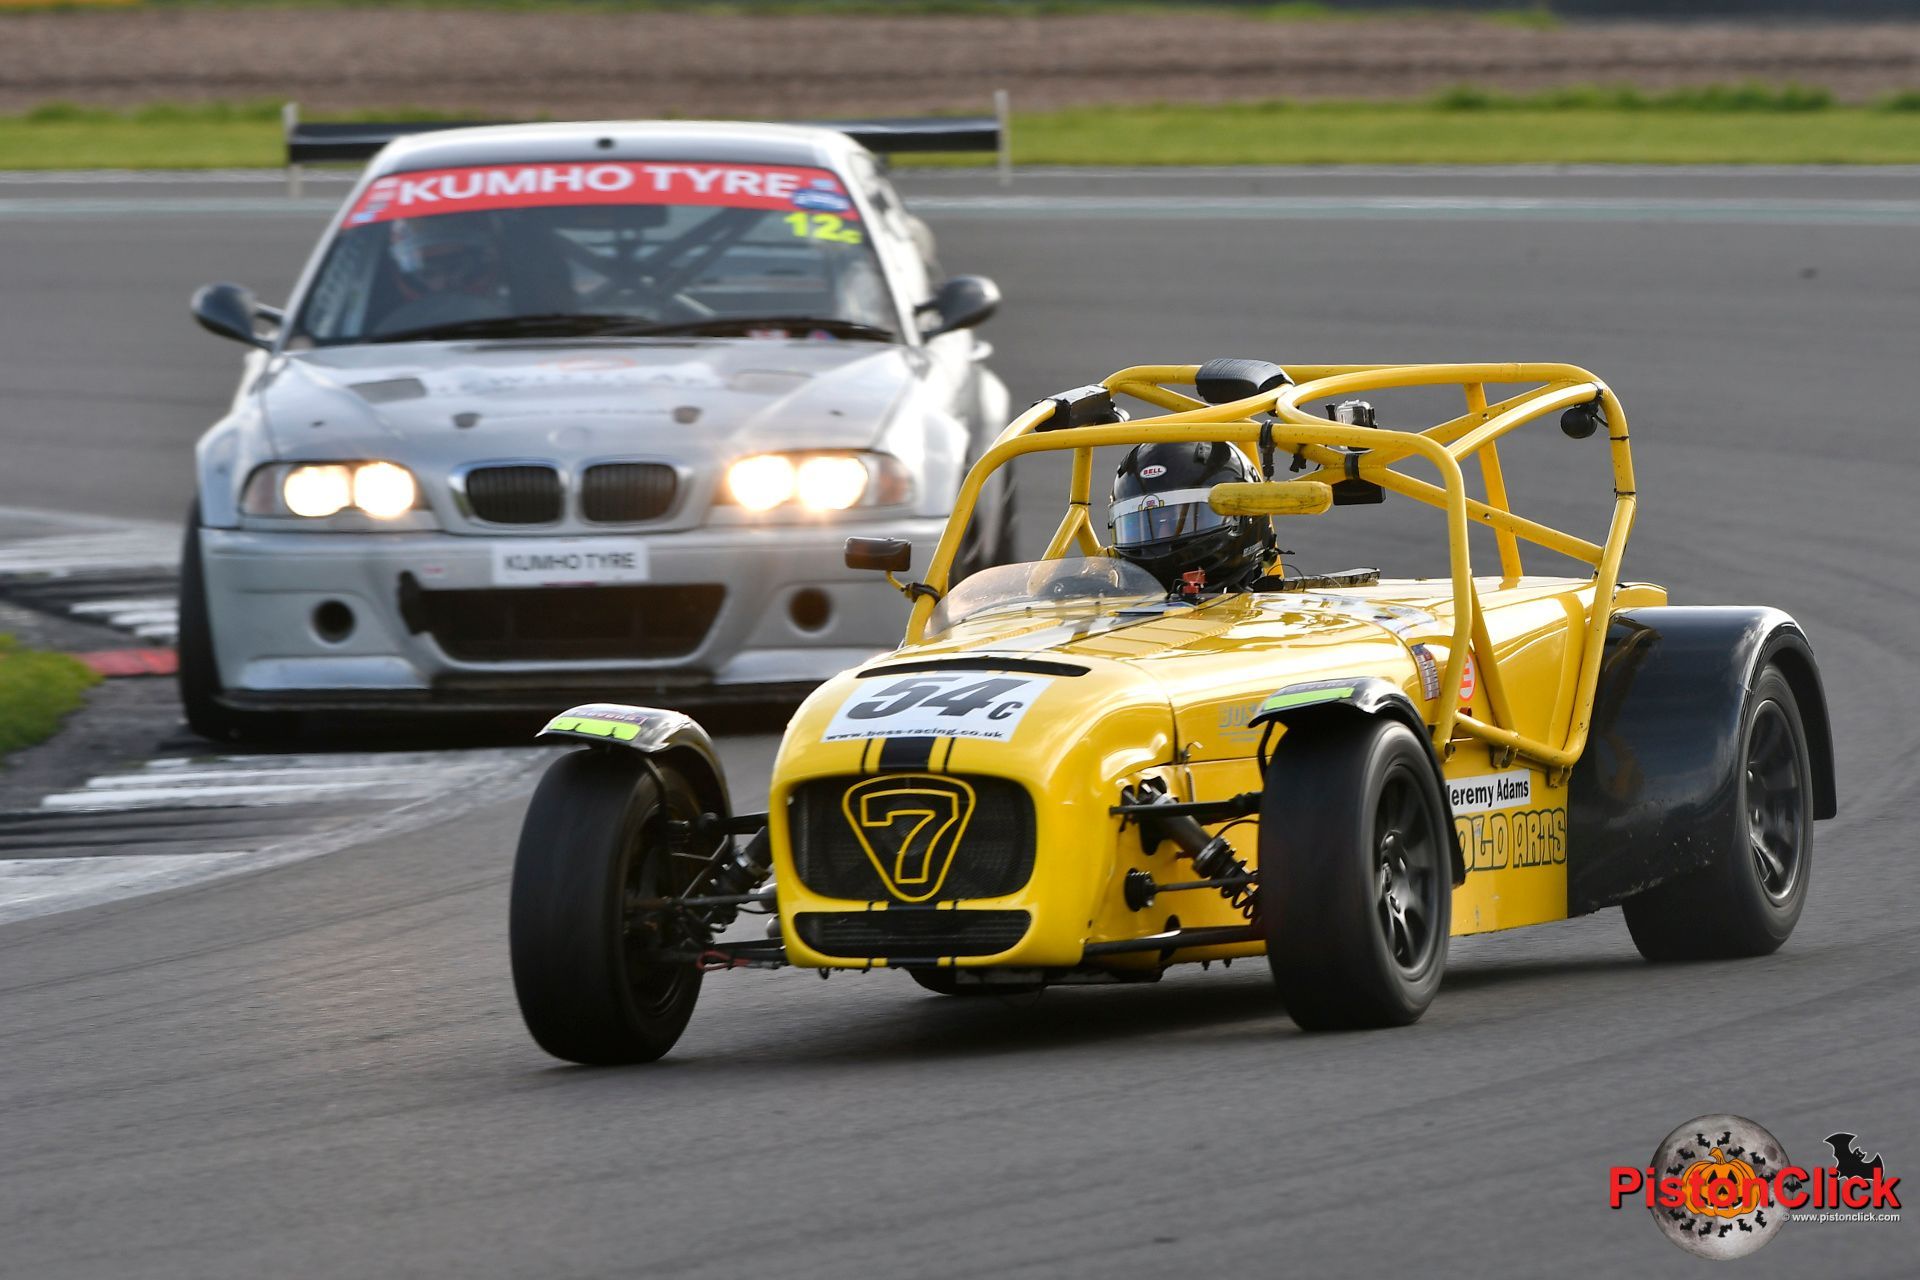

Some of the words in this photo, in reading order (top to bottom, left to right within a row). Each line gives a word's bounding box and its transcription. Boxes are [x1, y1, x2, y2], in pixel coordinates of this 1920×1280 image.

[397, 165, 634, 206] KUMHO
[642, 164, 800, 199] TYRE
[1143, 467, 1163, 475] BELL
[503, 554, 581, 572] KUMHO
[584, 552, 636, 570] TYRE
[825, 727, 1003, 740] www.boss-racing.co.uk
[1497, 777, 1529, 801] Adams
[861, 788, 959, 884] 7
[1512, 807, 1567, 868] ARTS
